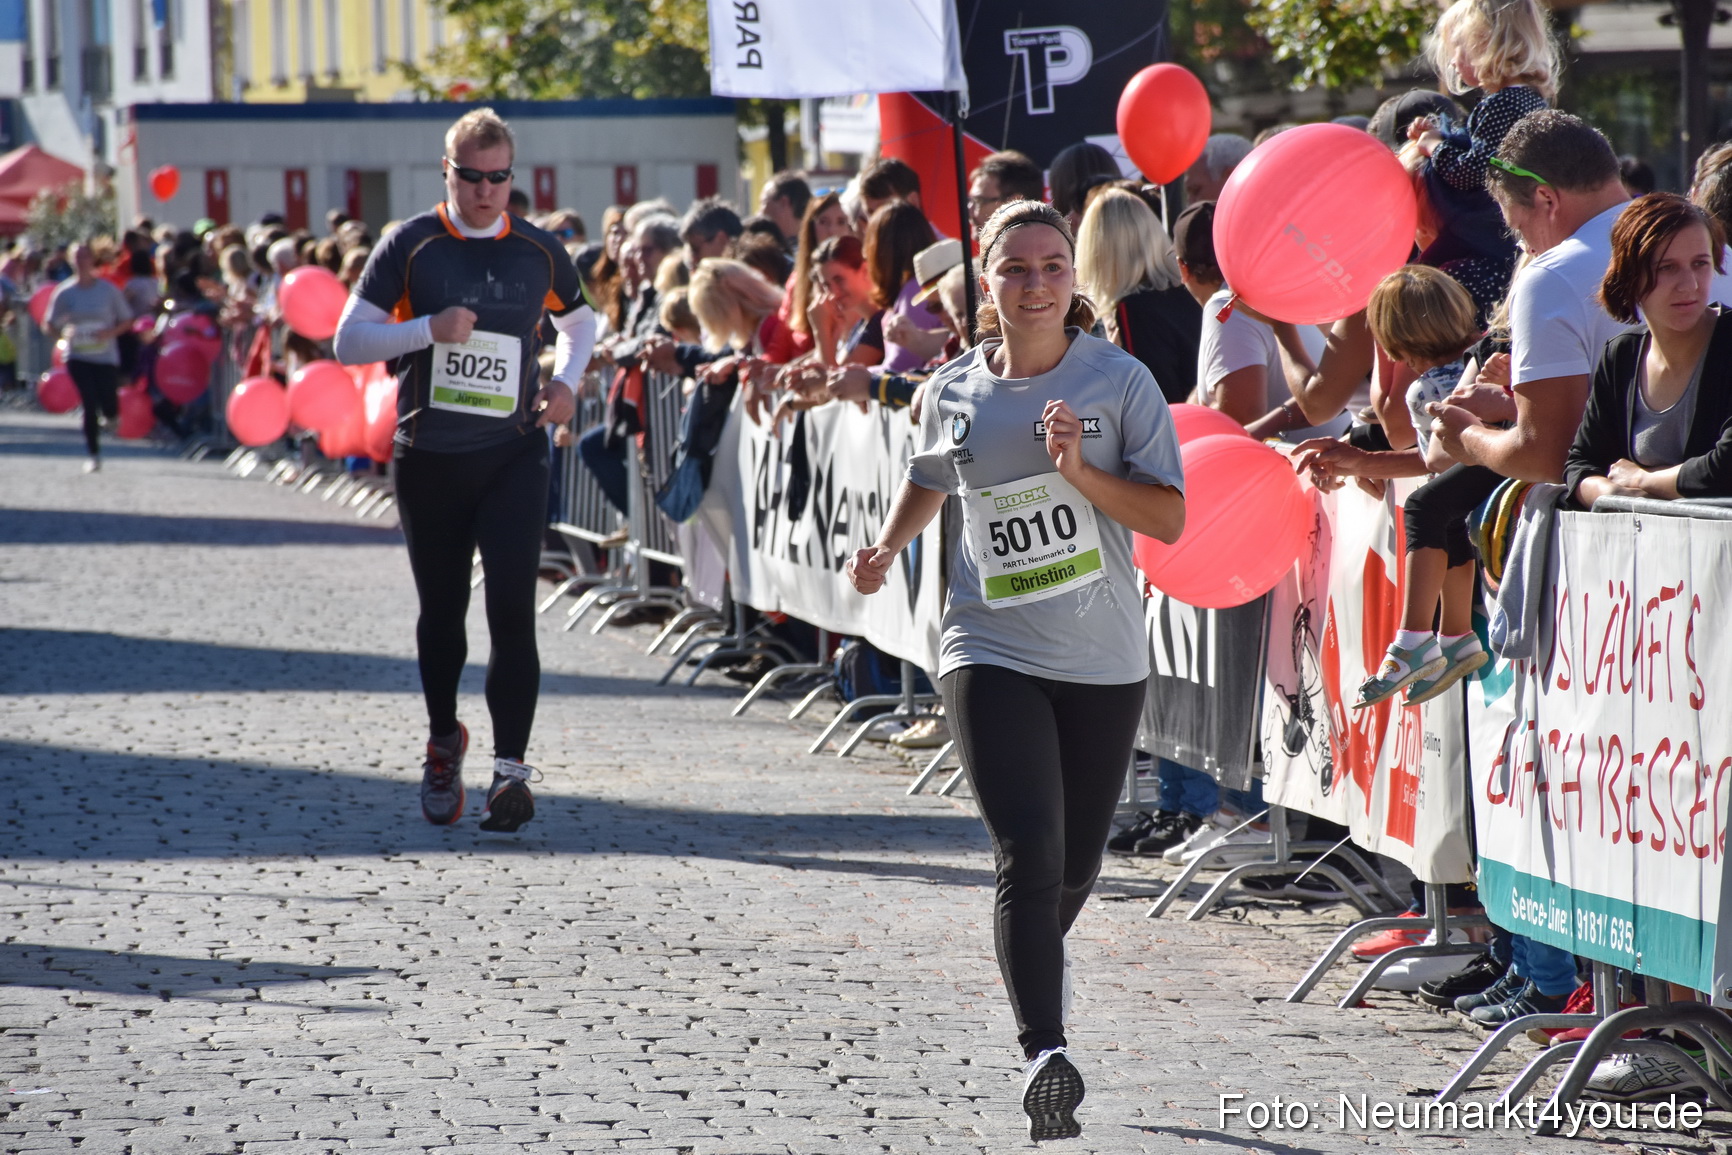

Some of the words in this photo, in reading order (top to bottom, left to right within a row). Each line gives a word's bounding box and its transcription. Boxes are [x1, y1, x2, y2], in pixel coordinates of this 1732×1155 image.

[445, 352, 508, 383] 5025
[454, 391, 491, 407] Jürgen
[1034, 418, 1102, 437] BK
[994, 485, 1050, 510] BOCK
[989, 503, 1078, 557] 5010
[1002, 559, 1028, 570] PARTL
[1028, 548, 1066, 564] Neumarkt
[1010, 564, 1076, 592] Christina
